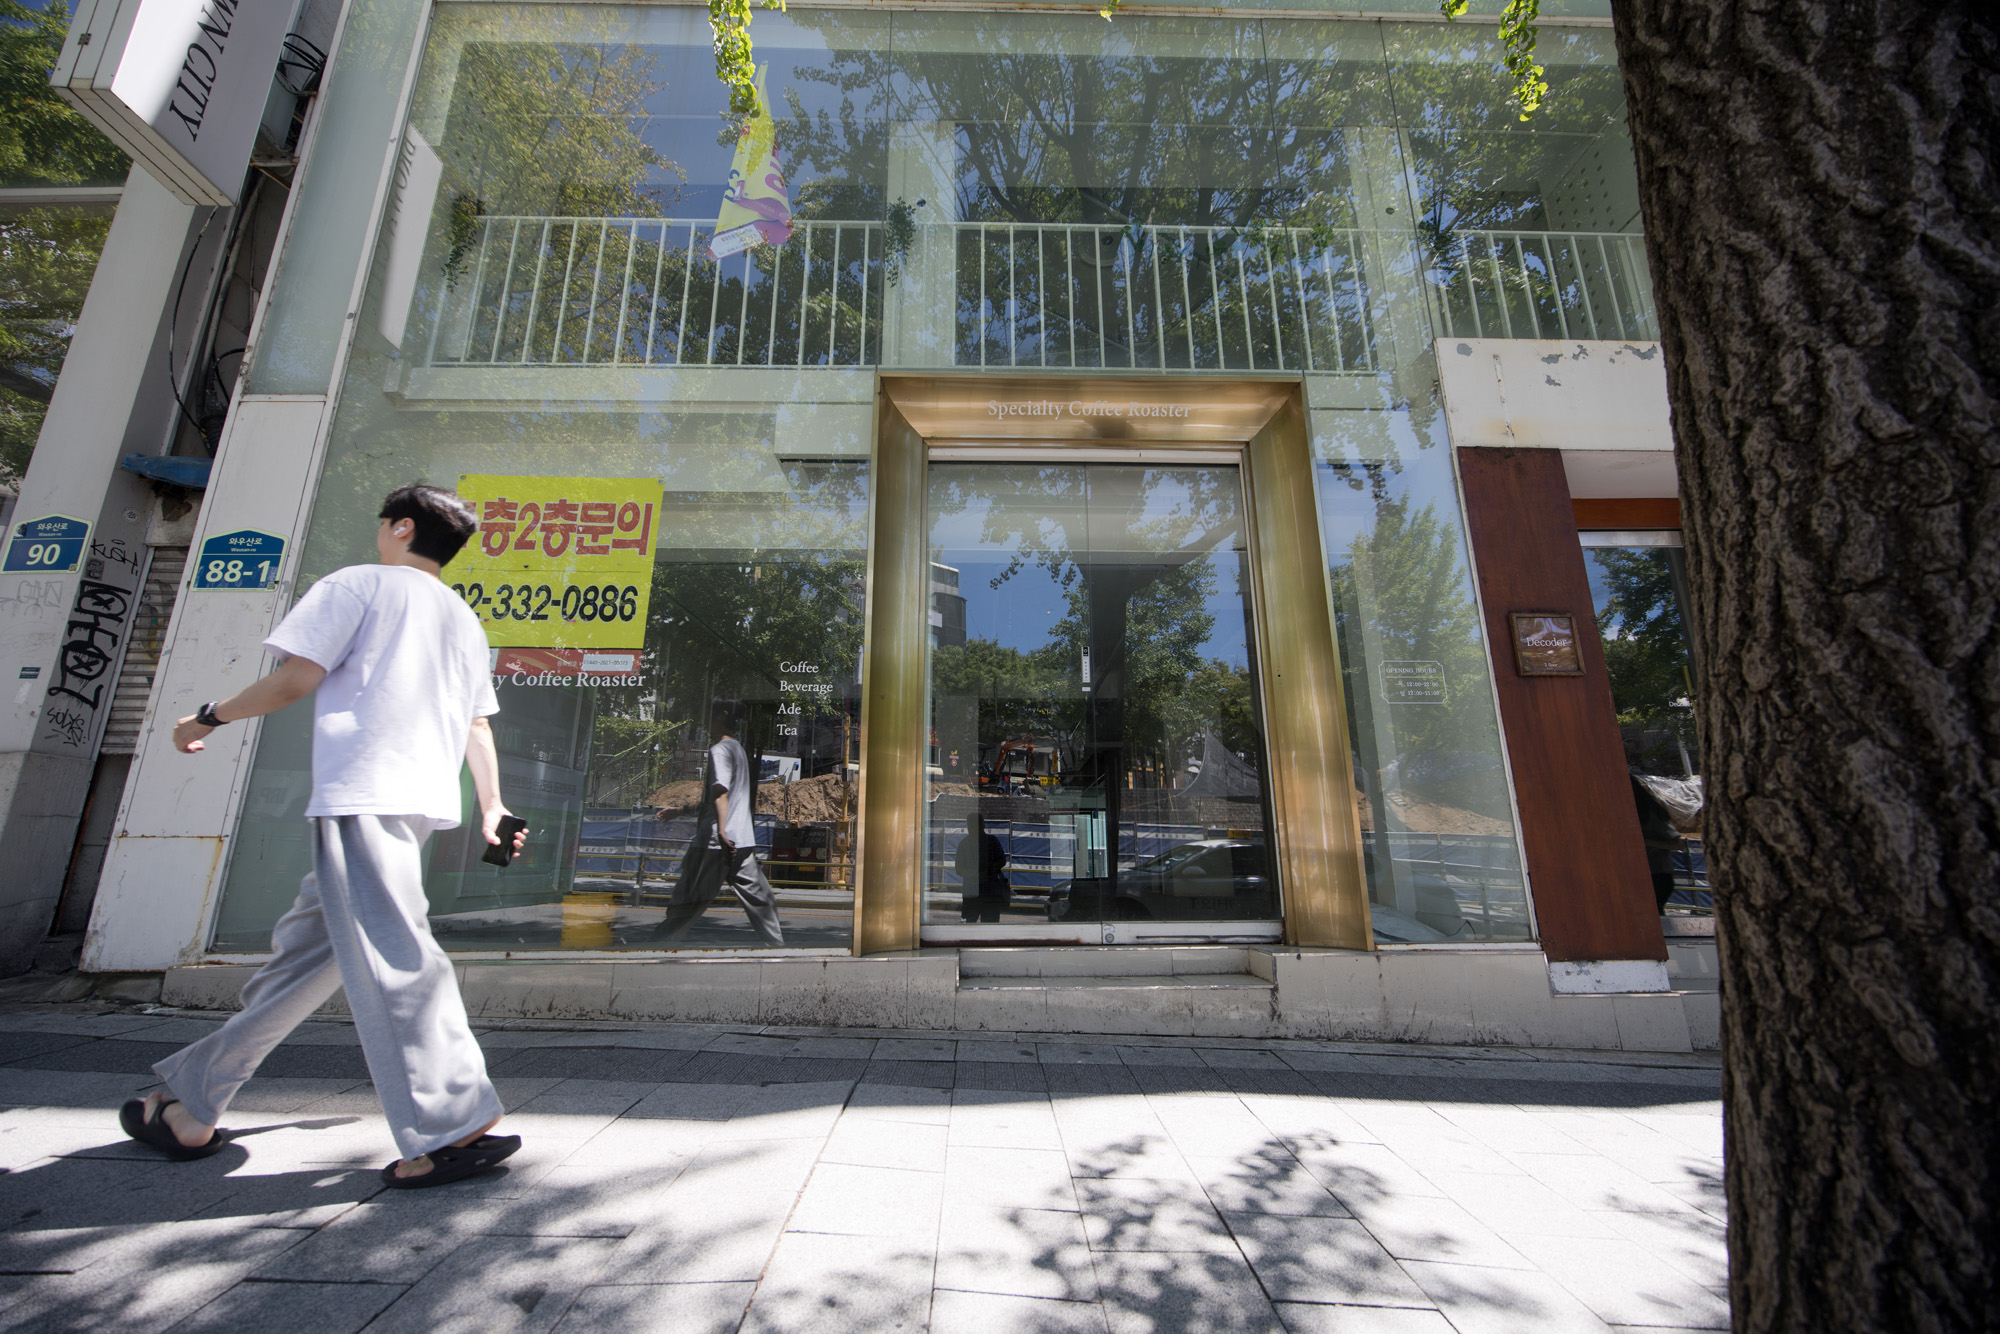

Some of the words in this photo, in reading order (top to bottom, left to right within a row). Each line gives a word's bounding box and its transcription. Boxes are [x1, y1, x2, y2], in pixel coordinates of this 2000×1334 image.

[169, 43, 217, 142] CITY
[988, 400, 1064, 420] Specialty
[1069, 400, 1124, 417] Coffee
[1128, 401, 1193, 418] Roaster
[36, 522, 69, 531] 와우산로
[464, 497, 654, 558] 층2층문의
[228, 537, 262, 546] 와우산로
[26, 544, 61, 565] 90
[205, 560, 271, 583] 88-1
[1526, 637, 1567, 647] Decoder
[780, 661, 819, 673] Coffee
[512, 670, 571, 687] Coffee
[575, 672, 646, 687] Roaster
[779, 680, 834, 695] Beverage
[776, 703, 802, 715] Ade
[776, 724, 798, 736] Tea
